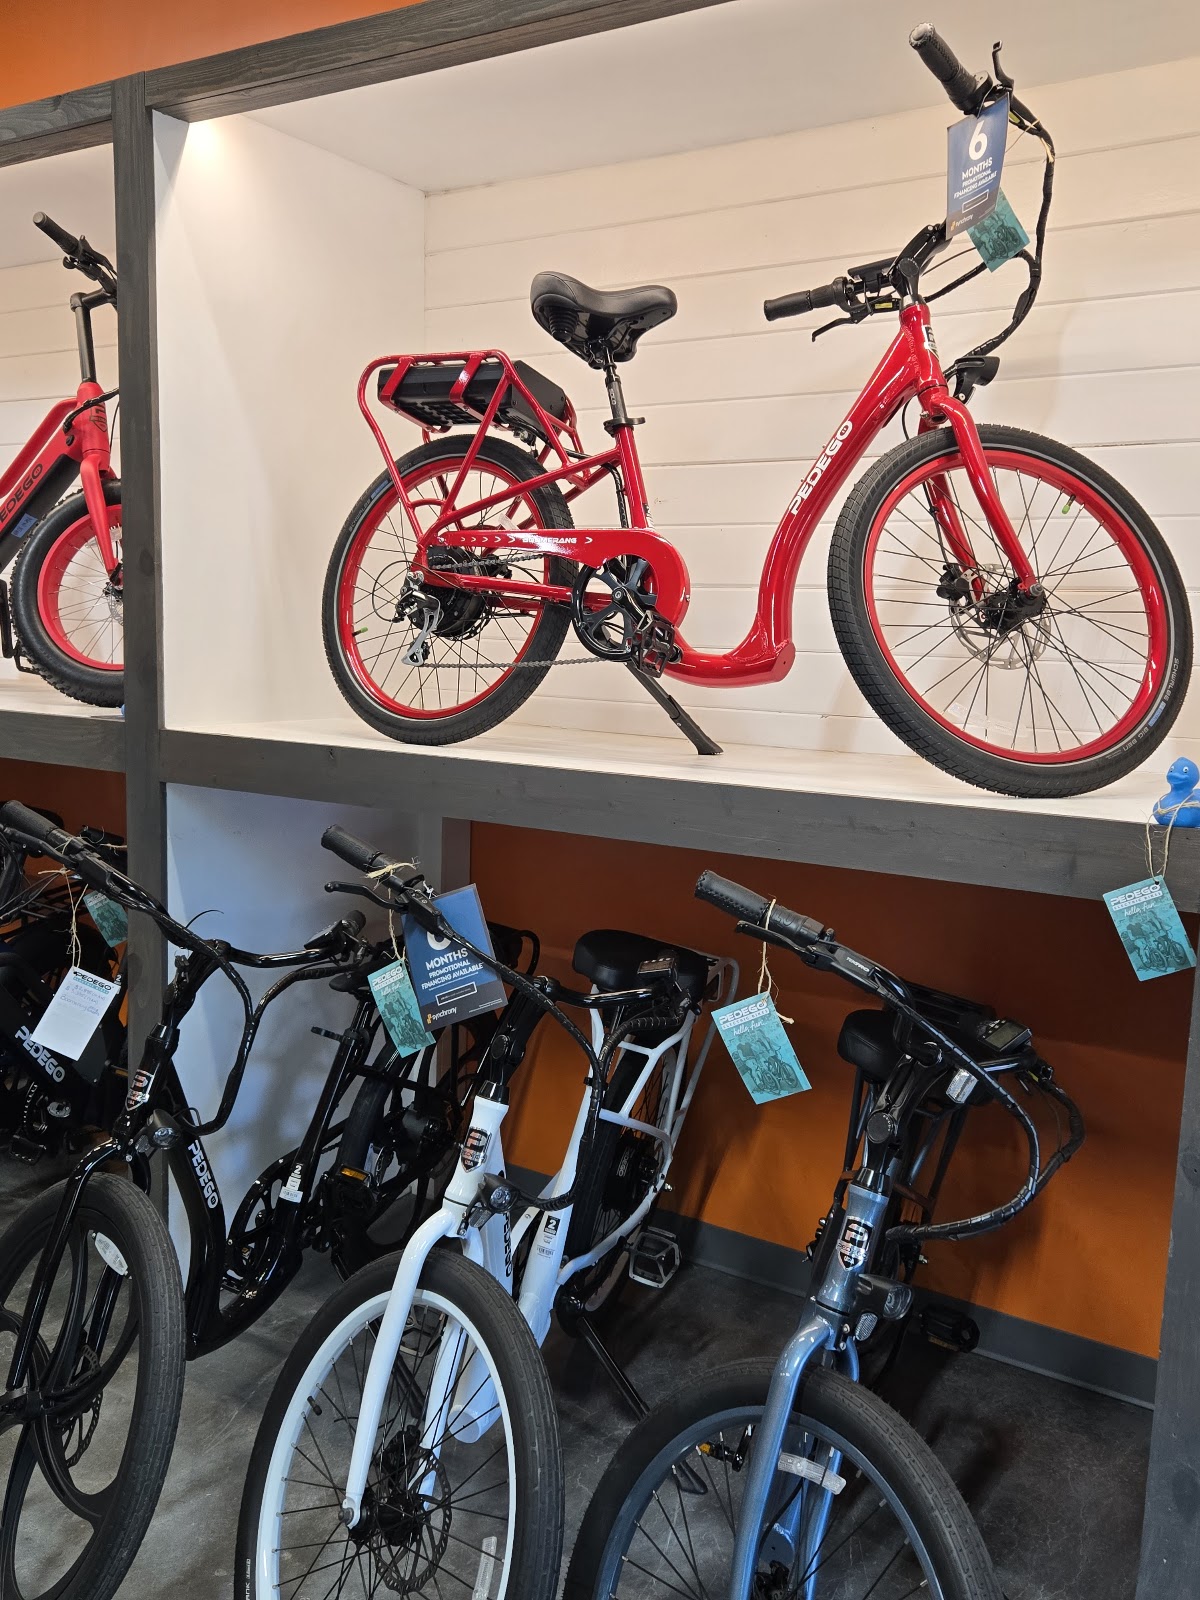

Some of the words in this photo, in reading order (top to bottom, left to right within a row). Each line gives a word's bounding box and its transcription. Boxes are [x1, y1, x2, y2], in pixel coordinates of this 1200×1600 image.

[969, 120, 988, 161] 6
[962, 157, 993, 180] MONTHS
[962, 168, 992, 187] PROMOTIONAL
[954, 183, 978, 199] FINANCING
[978, 171, 998, 187] AVAILABLE
[788, 420, 853, 516] PEDEGO
[1164, 657, 1179, 701] SCHWALBE
[1110, 884, 1161, 906] PEDEGO
[425, 947, 469, 971] MONTHS
[428, 959, 471, 979] PROMOTIONAL
[74, 971, 112, 991] PEDEGO
[371, 965, 403, 987] PEDEGO
[421, 974, 452, 990] FINANCING
[452, 961, 484, 979] AVAILABLE
[431, 1006, 457, 1021] synchrony
[718, 1001, 768, 1025] PEDEGO
[722, 1016, 750, 1029] ELECTRIC
[733, 1023, 750, 1036] hello,
[15, 1025, 66, 1083] PEDEGO
[187, 1139, 220, 1209] PEDEGO
[547, 1219, 557, 1230] 2
